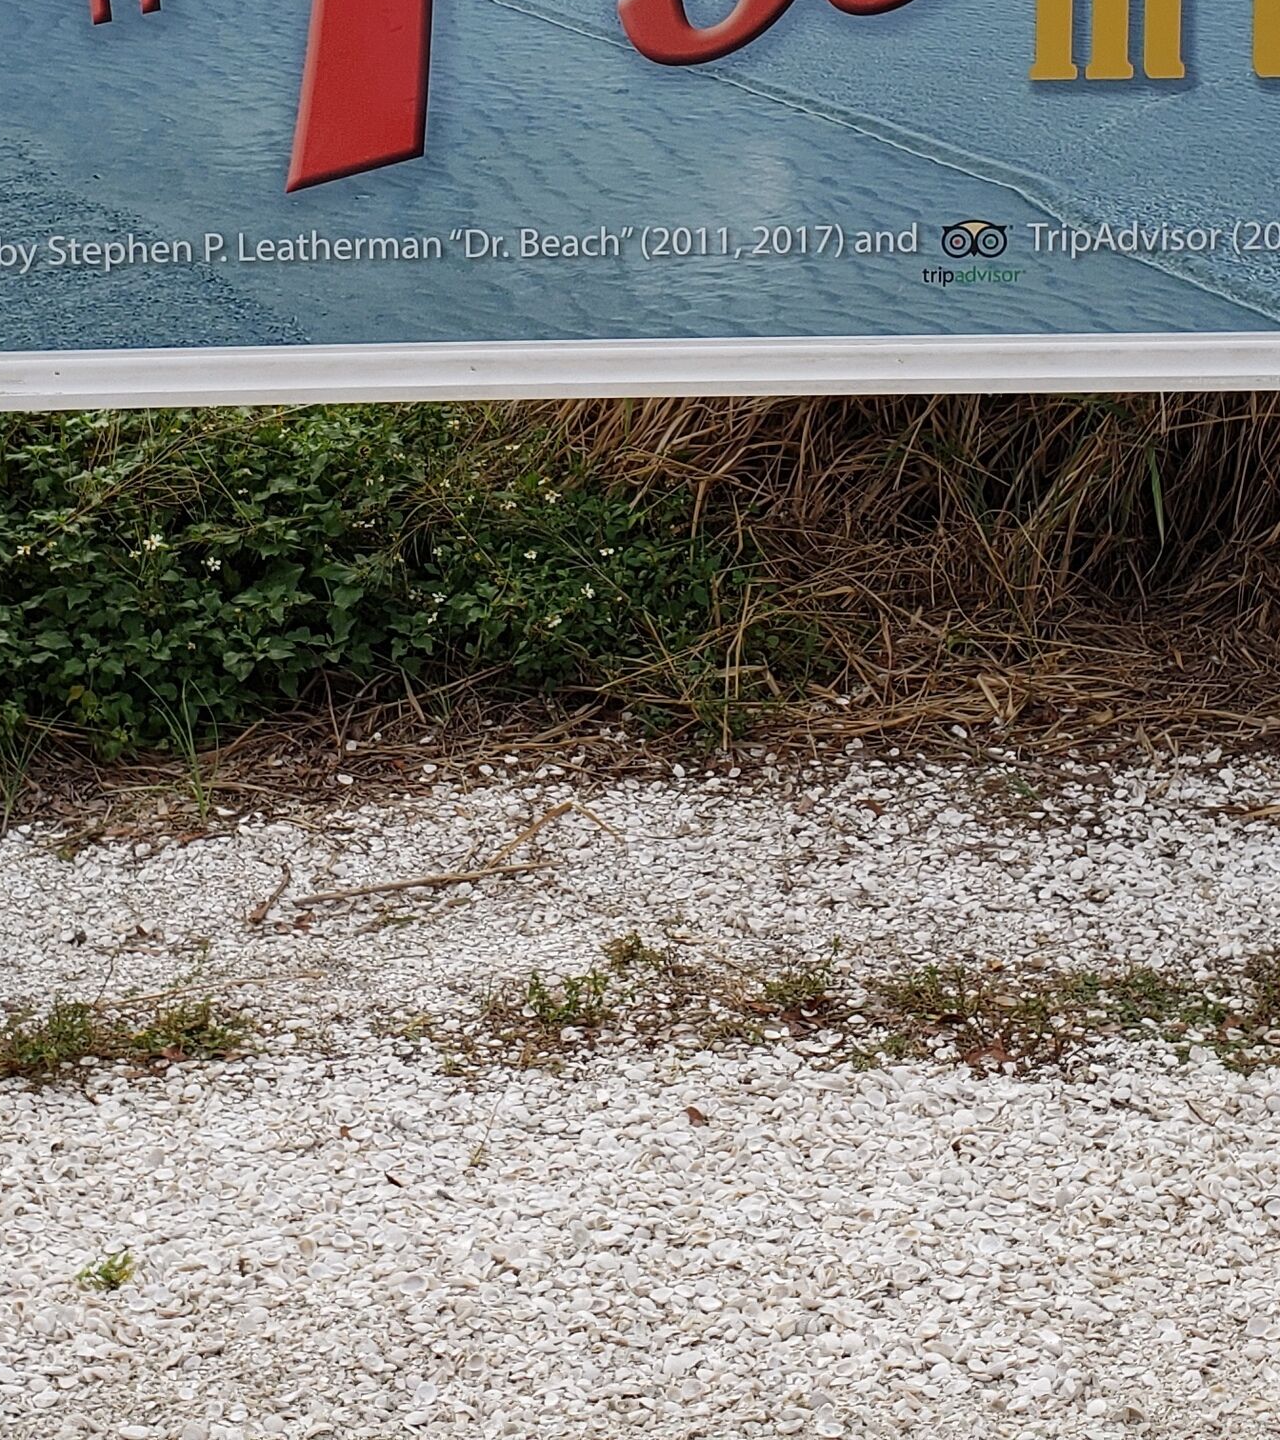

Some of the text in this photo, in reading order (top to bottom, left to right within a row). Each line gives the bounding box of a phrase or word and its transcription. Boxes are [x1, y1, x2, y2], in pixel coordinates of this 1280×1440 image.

[47, 233, 193, 272] Stephen
[204, 233, 227, 262] P.
[237, 229, 442, 262] Leatherman
[640, 225, 742, 261] (2011,
[752, 222, 845, 260] 2017)
[854, 222, 918, 254] and
[1026, 218, 1222, 259] TripAdvisor
[922, 265, 1021, 287] tripadvisor
